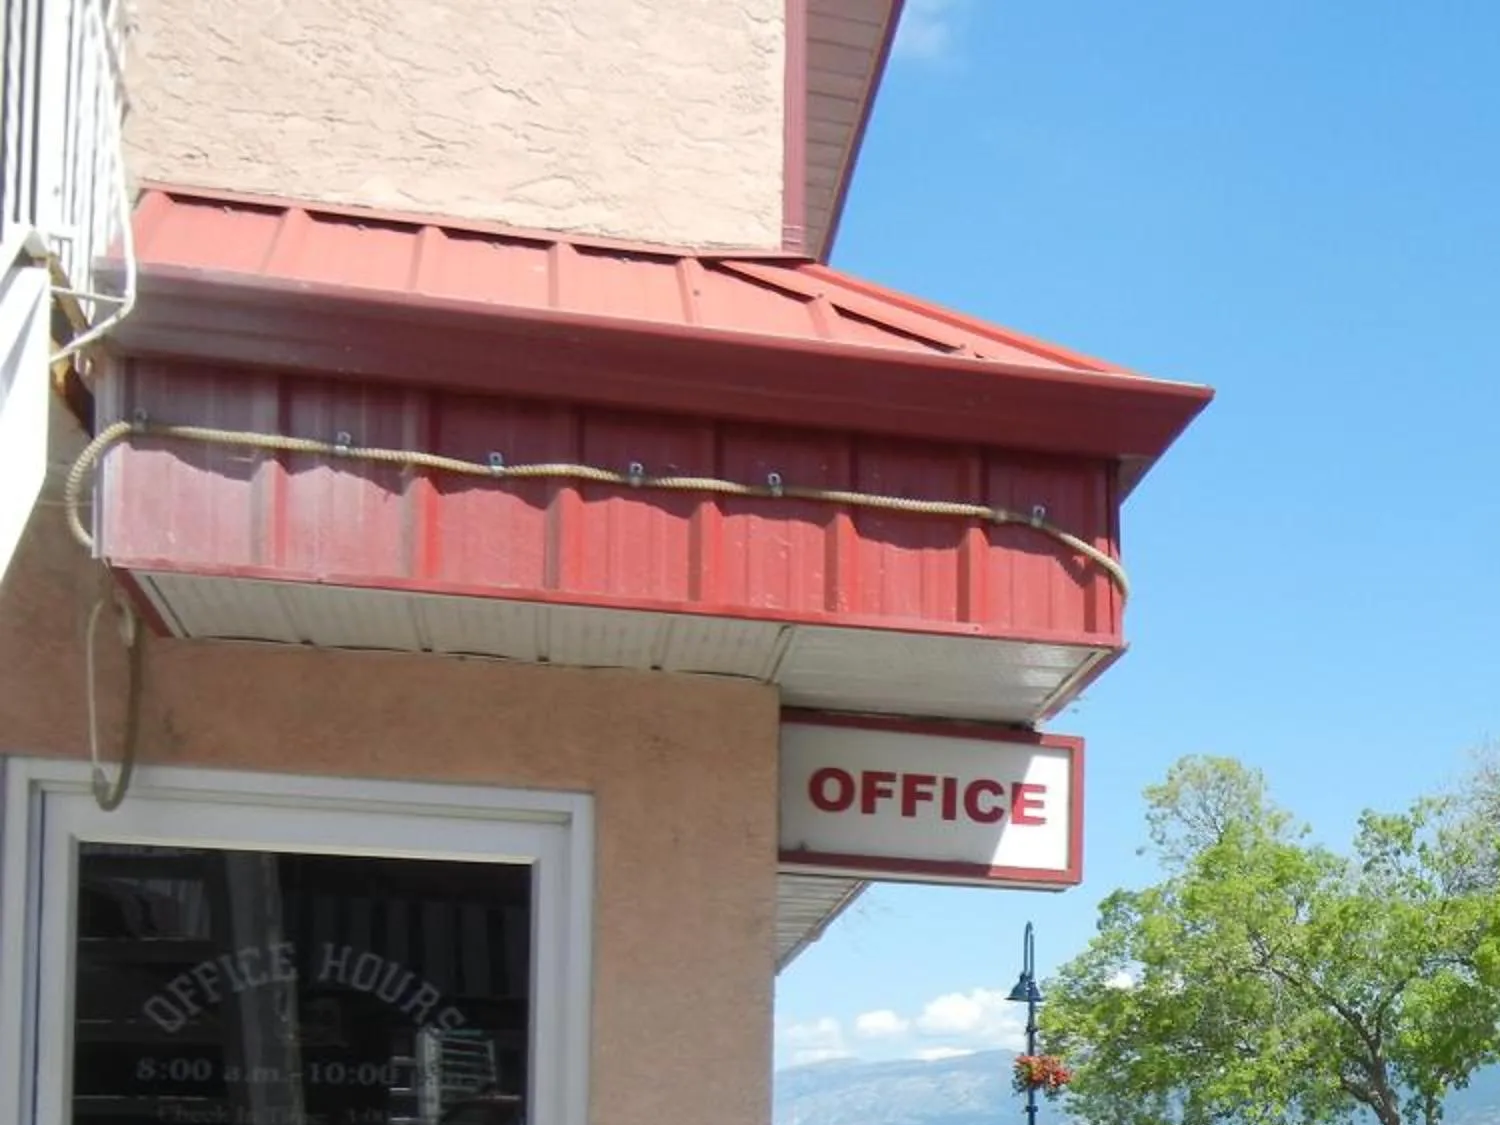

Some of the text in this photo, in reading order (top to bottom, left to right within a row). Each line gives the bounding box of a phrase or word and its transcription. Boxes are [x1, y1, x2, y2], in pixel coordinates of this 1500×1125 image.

[808, 767, 1047, 825] OFFICE
[143, 940, 468, 1034] OFFICE HOURS
[136, 1057, 213, 1081] 8:00
[309, 1061, 400, 1085] 10:00
